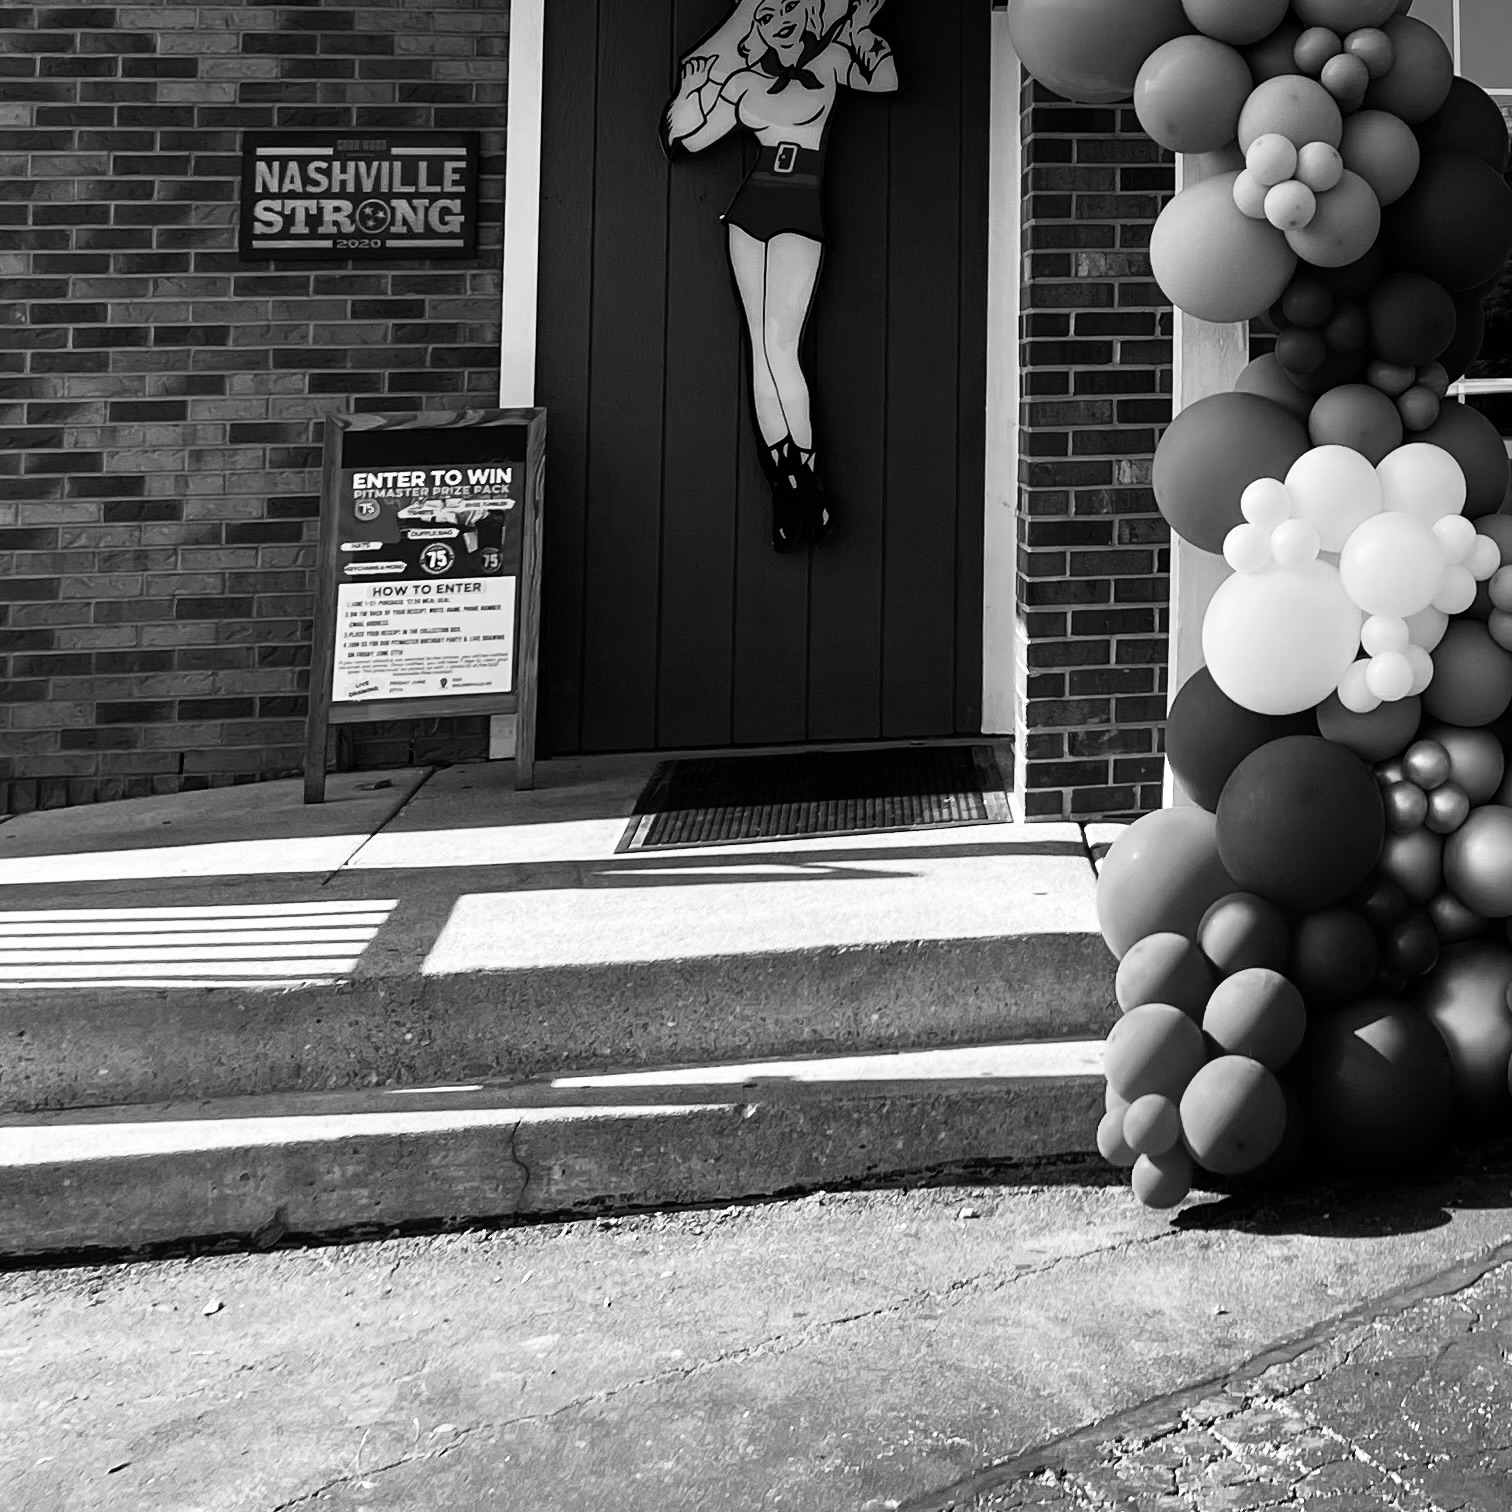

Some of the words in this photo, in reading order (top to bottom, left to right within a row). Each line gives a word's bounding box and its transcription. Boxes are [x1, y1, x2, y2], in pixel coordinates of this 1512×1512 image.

[254, 160, 467, 193] NASHVILLE
[252, 198, 465, 235] STRONG
[335, 239, 382, 248] 2020
[352, 470, 426, 490] ENTER
[430, 469, 463, 487] TO
[467, 467, 512, 485] WIN
[353, 487, 429, 499] PITMASTER
[432, 485, 470, 496] PRIZE
[474, 484, 510, 494] PACK
[358, 502, 375, 515] 75
[427, 549, 448, 569] 75
[482, 553, 499, 569] 75
[372, 585, 408, 597] HOW
[412, 584, 432, 595] TO
[436, 582, 482, 594] ENTER
